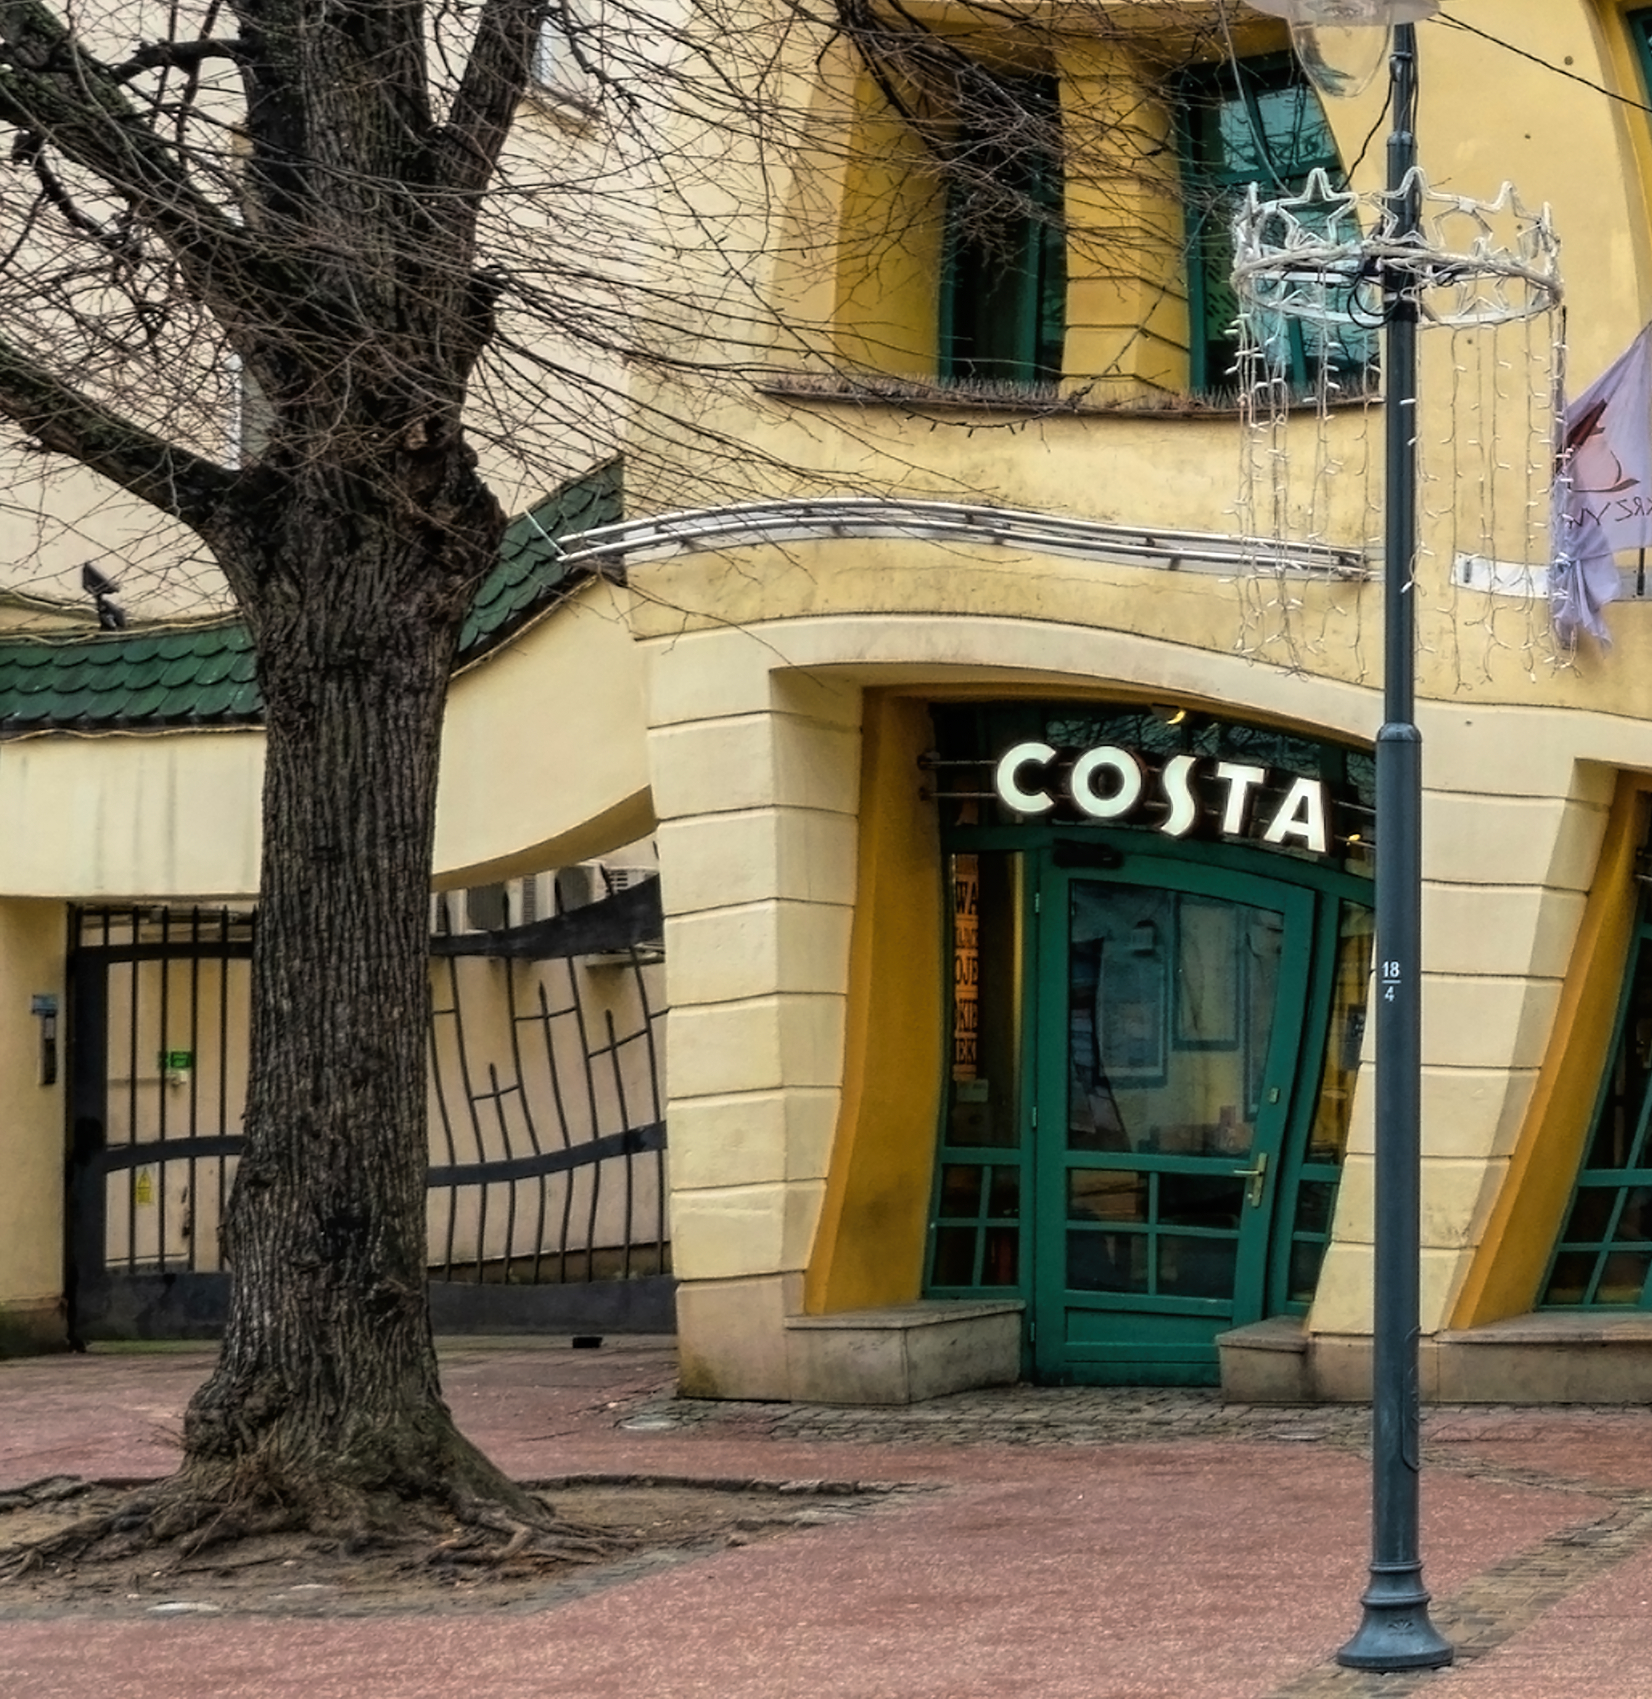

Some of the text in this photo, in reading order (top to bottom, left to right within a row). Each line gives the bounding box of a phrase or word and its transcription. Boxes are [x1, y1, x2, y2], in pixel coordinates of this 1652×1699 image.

[997, 741, 1327, 853] COSTA
[1381, 961, 1400, 977] 18
[1384, 986, 1395, 1002] 4
